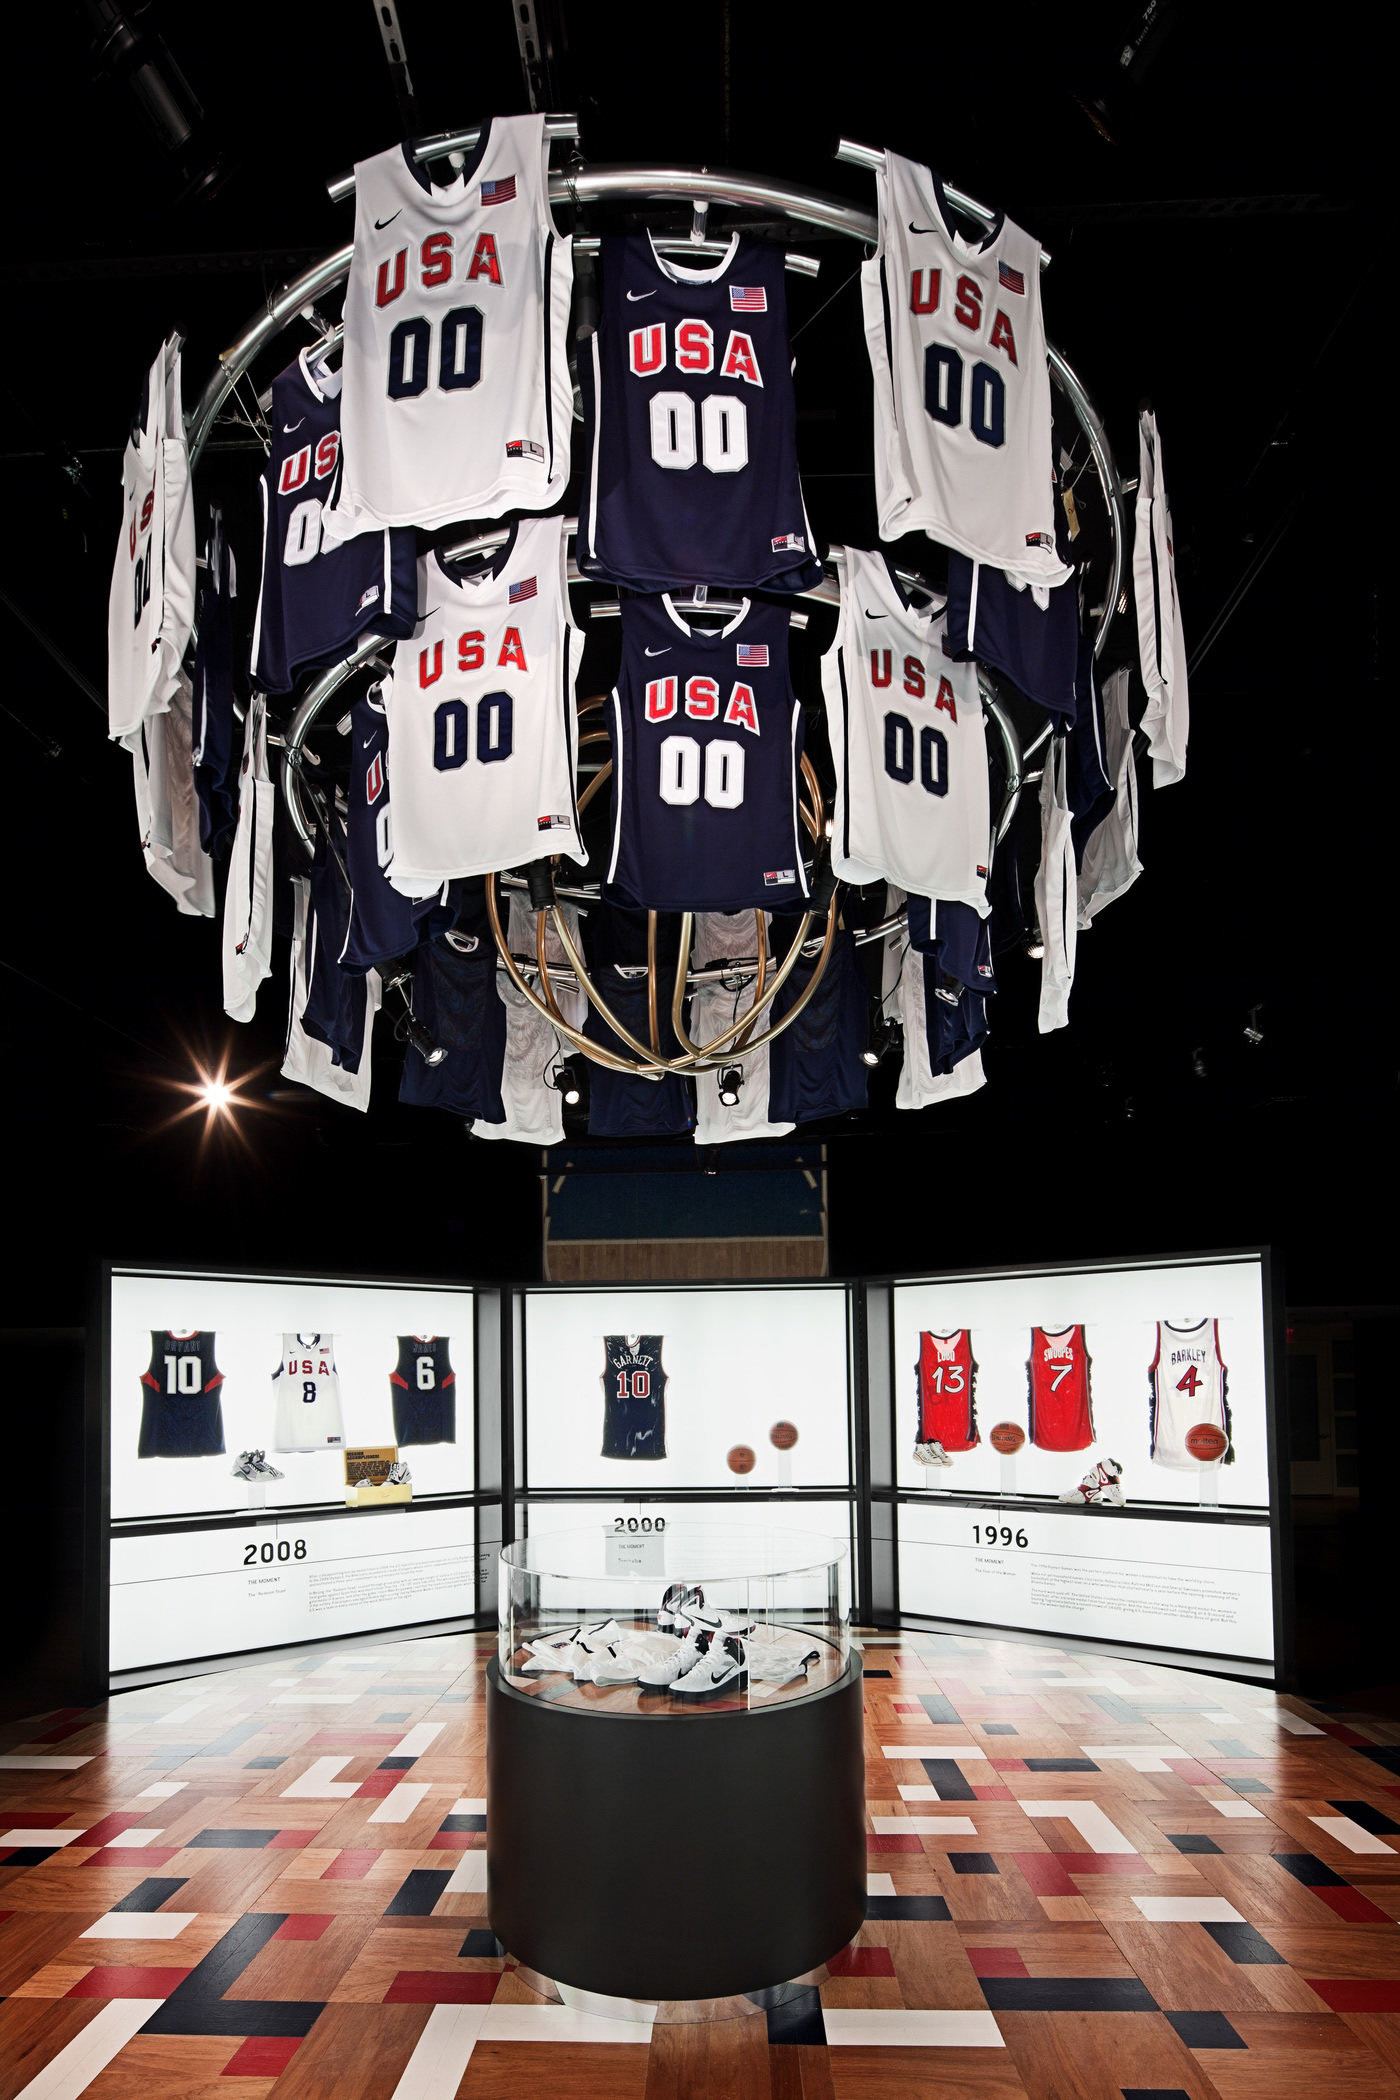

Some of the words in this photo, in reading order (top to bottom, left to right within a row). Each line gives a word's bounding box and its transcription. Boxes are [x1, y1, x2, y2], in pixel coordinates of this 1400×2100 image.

[374, 231, 505, 310] USA
[910, 268, 1021, 372] USA
[385, 304, 486, 403] 00
[628, 319, 764, 388] USA
[924, 341, 1007, 449] 00
[649, 391, 749, 473] 00
[418, 626, 528, 689] USA
[645, 675, 760, 736] USA
[870, 648, 958, 725] USA
[433, 688, 515, 773] 00
[659, 735, 745, 809] 00
[883, 710, 949, 799] 00
[289, 1360, 330, 1376] USA
[613, 1354, 654, 1369] GARNETT
[1043, 1346, 1073, 1361] SWOOPES
[1171, 1348, 1206, 1365] BARKLEY
[164, 1354, 202, 1395] 10
[302, 1381, 317, 1403] 8
[416, 1356, 436, 1391] 6
[616, 1370, 650, 1398] 10
[931, 1365, 965, 1394] 13
[1049, 1364, 1073, 1392] 7
[1175, 1364, 1204, 1397] 4
[614, 1517, 666, 1533] 2000
[972, 1525, 1029, 1548] 1996
[243, 1539, 307, 1565] 2008
